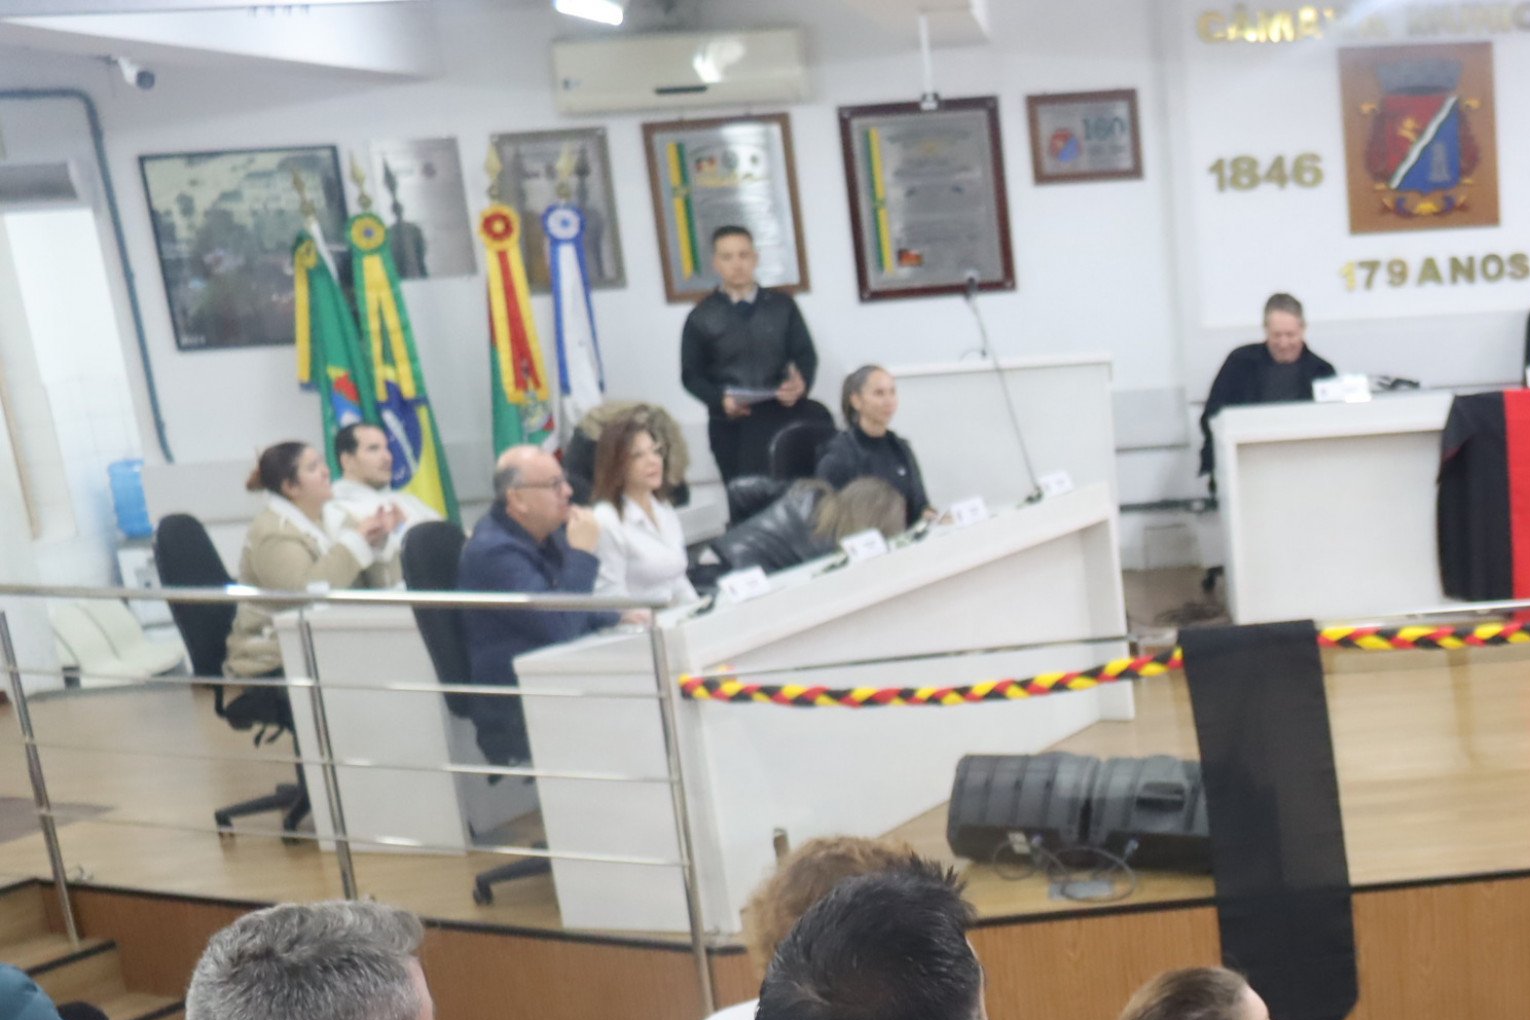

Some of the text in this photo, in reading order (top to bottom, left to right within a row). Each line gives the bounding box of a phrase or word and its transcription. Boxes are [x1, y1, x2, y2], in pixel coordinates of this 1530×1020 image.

[1208, 153, 1324, 192] 1846
[1339, 253, 1530, 290] 179 ANOS
